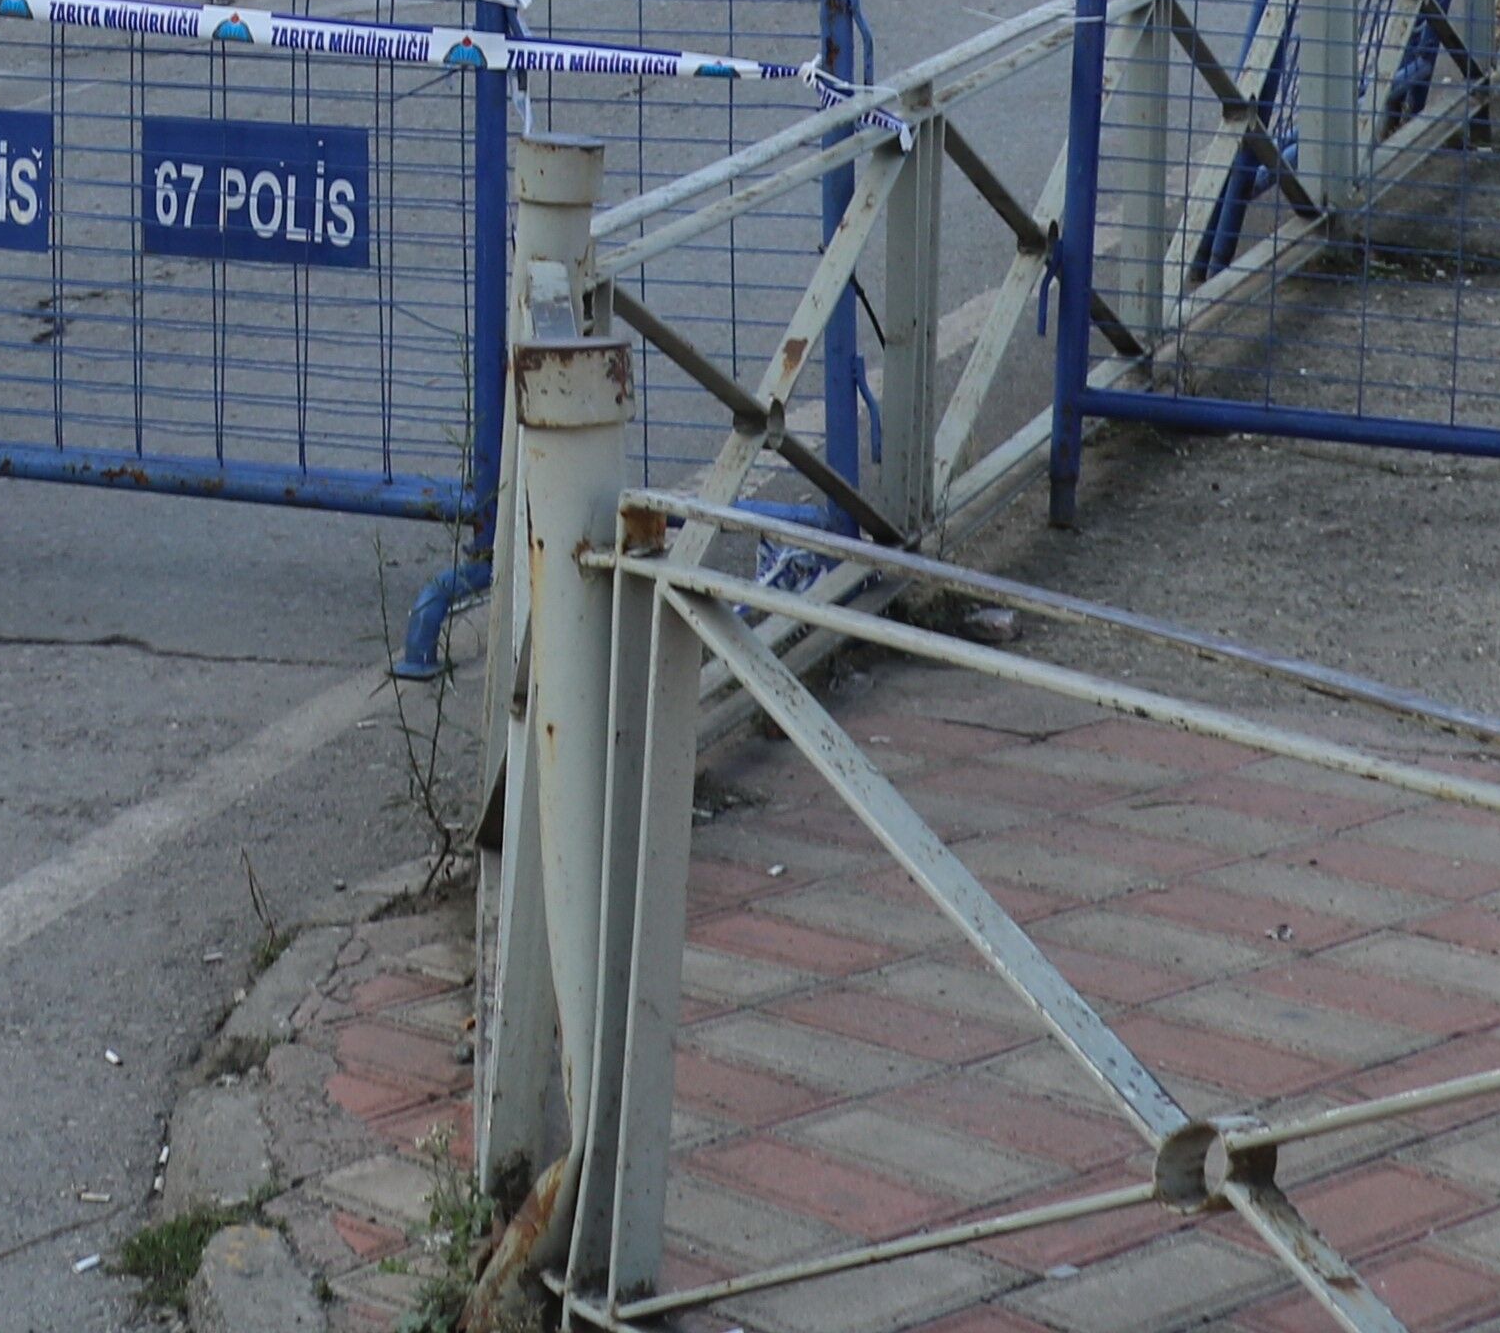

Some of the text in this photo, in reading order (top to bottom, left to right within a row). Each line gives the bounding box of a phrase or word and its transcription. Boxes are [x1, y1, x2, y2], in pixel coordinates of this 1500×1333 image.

[50, 1, 199, 37] ZABITA MÜDÜRLÜĞÜ
[271, 26, 430, 61] ZABITA MÜDÜRLÜĞÜ
[507, 48, 678, 75] ZABITA MÜDÜRLÜĞÜ
[155, 157, 356, 248] 67 POLİS
